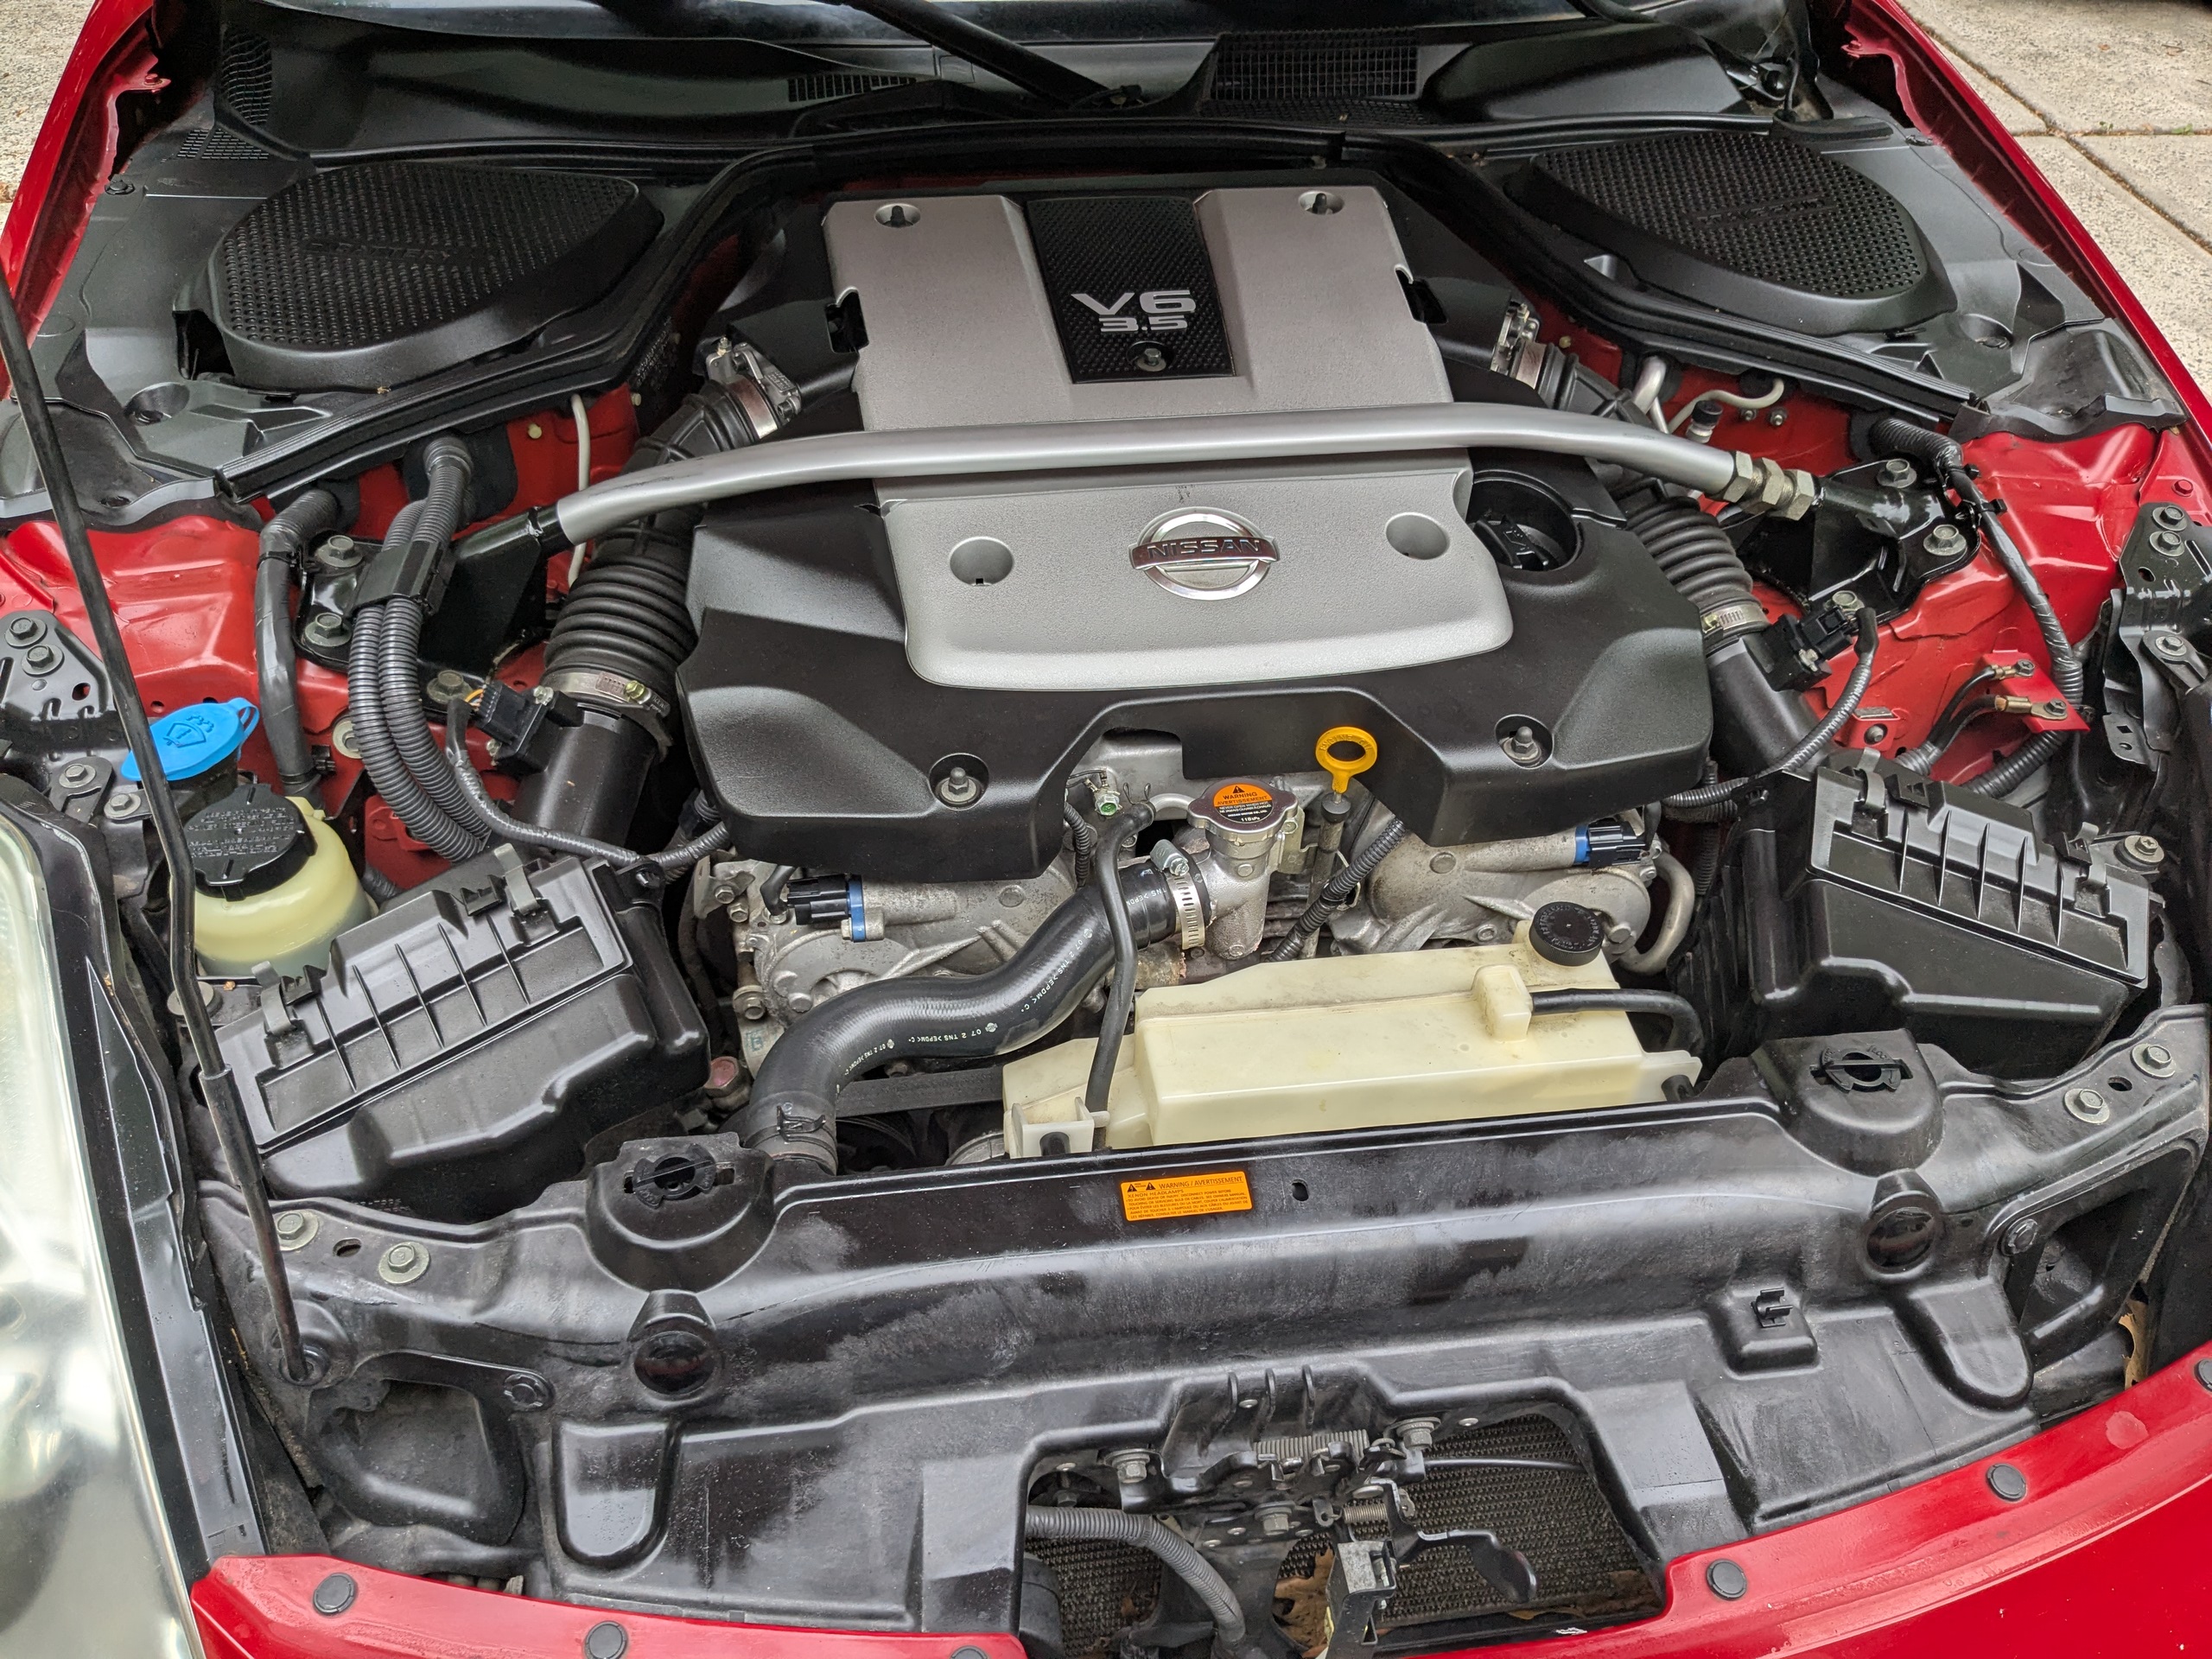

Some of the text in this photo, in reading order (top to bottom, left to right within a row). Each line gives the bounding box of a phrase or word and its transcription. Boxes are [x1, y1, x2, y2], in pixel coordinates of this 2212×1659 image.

[1071, 289, 1196, 315] V6
[1099, 315, 1188, 333] 3.5
[1147, 539, 1260, 559] NISSAN
[1320, 734, 1353, 752] ENGINE
[1217, 795, 1268, 805] AVERTISSEMENT
[1223, 791, 1257, 800] WARNING
[1076, 940, 1083, 950] 07
[1058, 959, 1069, 975] TNS
[1194, 1176, 1242, 1185] AVERTISSEMENT
